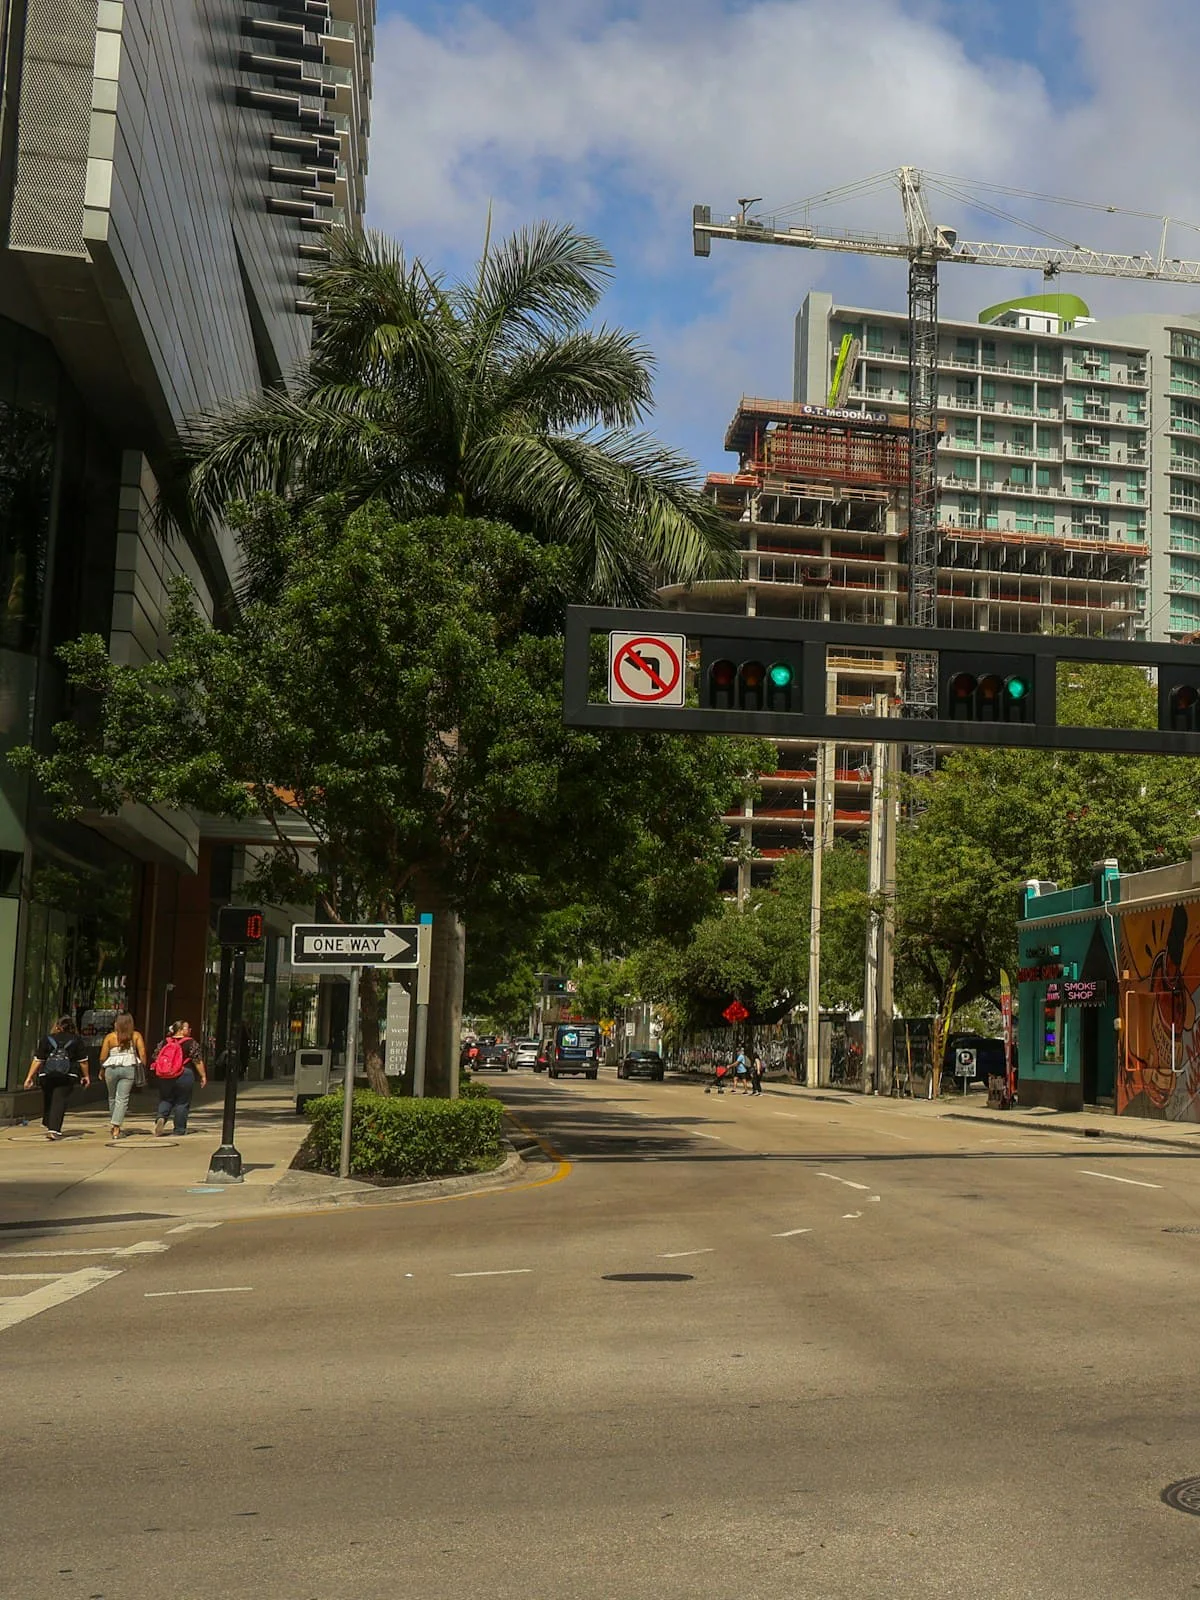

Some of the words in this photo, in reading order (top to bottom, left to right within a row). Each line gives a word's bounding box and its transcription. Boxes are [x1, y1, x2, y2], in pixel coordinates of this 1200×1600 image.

[246, 914, 263, 939] 10
[313, 938, 344, 951] ONE
[350, 938, 381, 951] WAY
[1064, 982, 1097, 991] SMOKE
[1068, 991, 1093, 1000] SHOP
